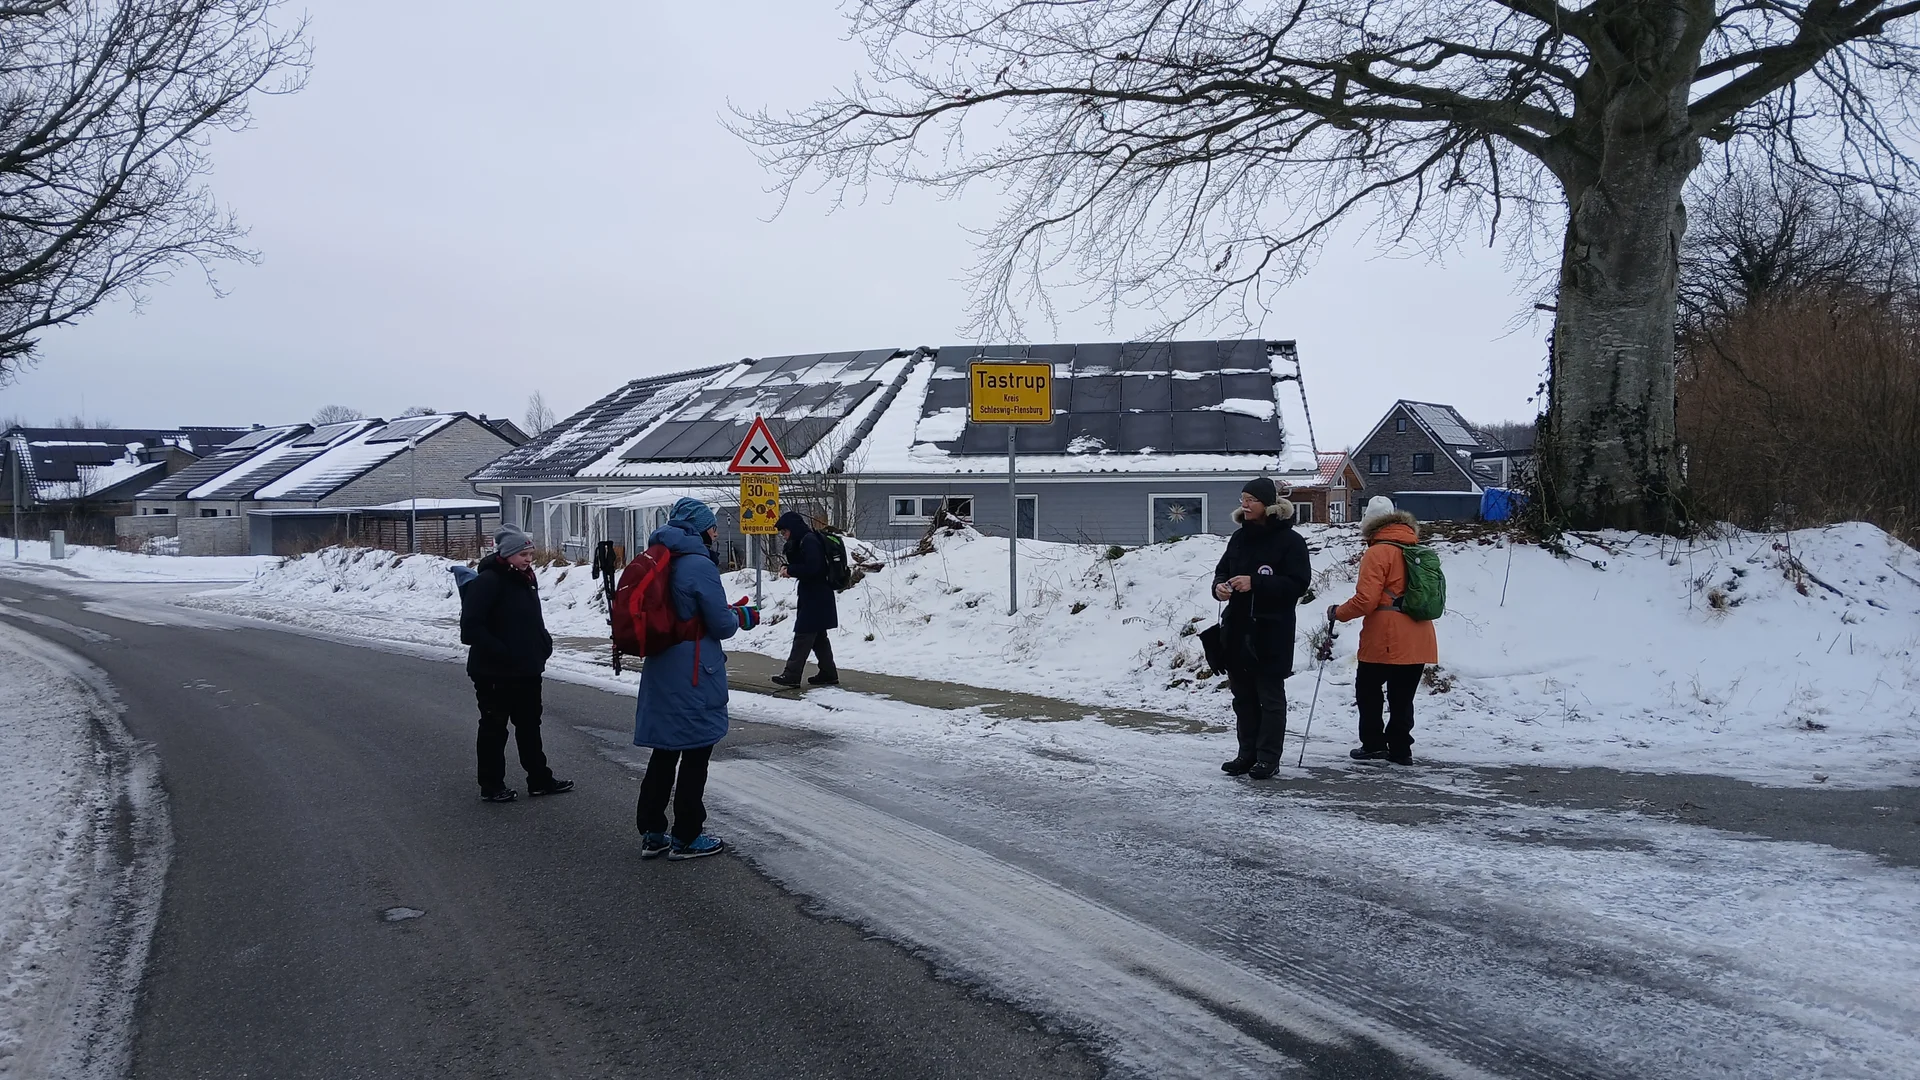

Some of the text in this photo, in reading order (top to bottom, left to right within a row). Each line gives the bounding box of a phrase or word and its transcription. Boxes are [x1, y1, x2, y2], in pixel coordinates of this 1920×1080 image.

[976, 370, 1046, 393] Tastrup
[1003, 394, 1019, 402] Kreis
[980, 405, 1043, 415] Schleswig-Flensburg
[747, 484, 763, 496] 30
